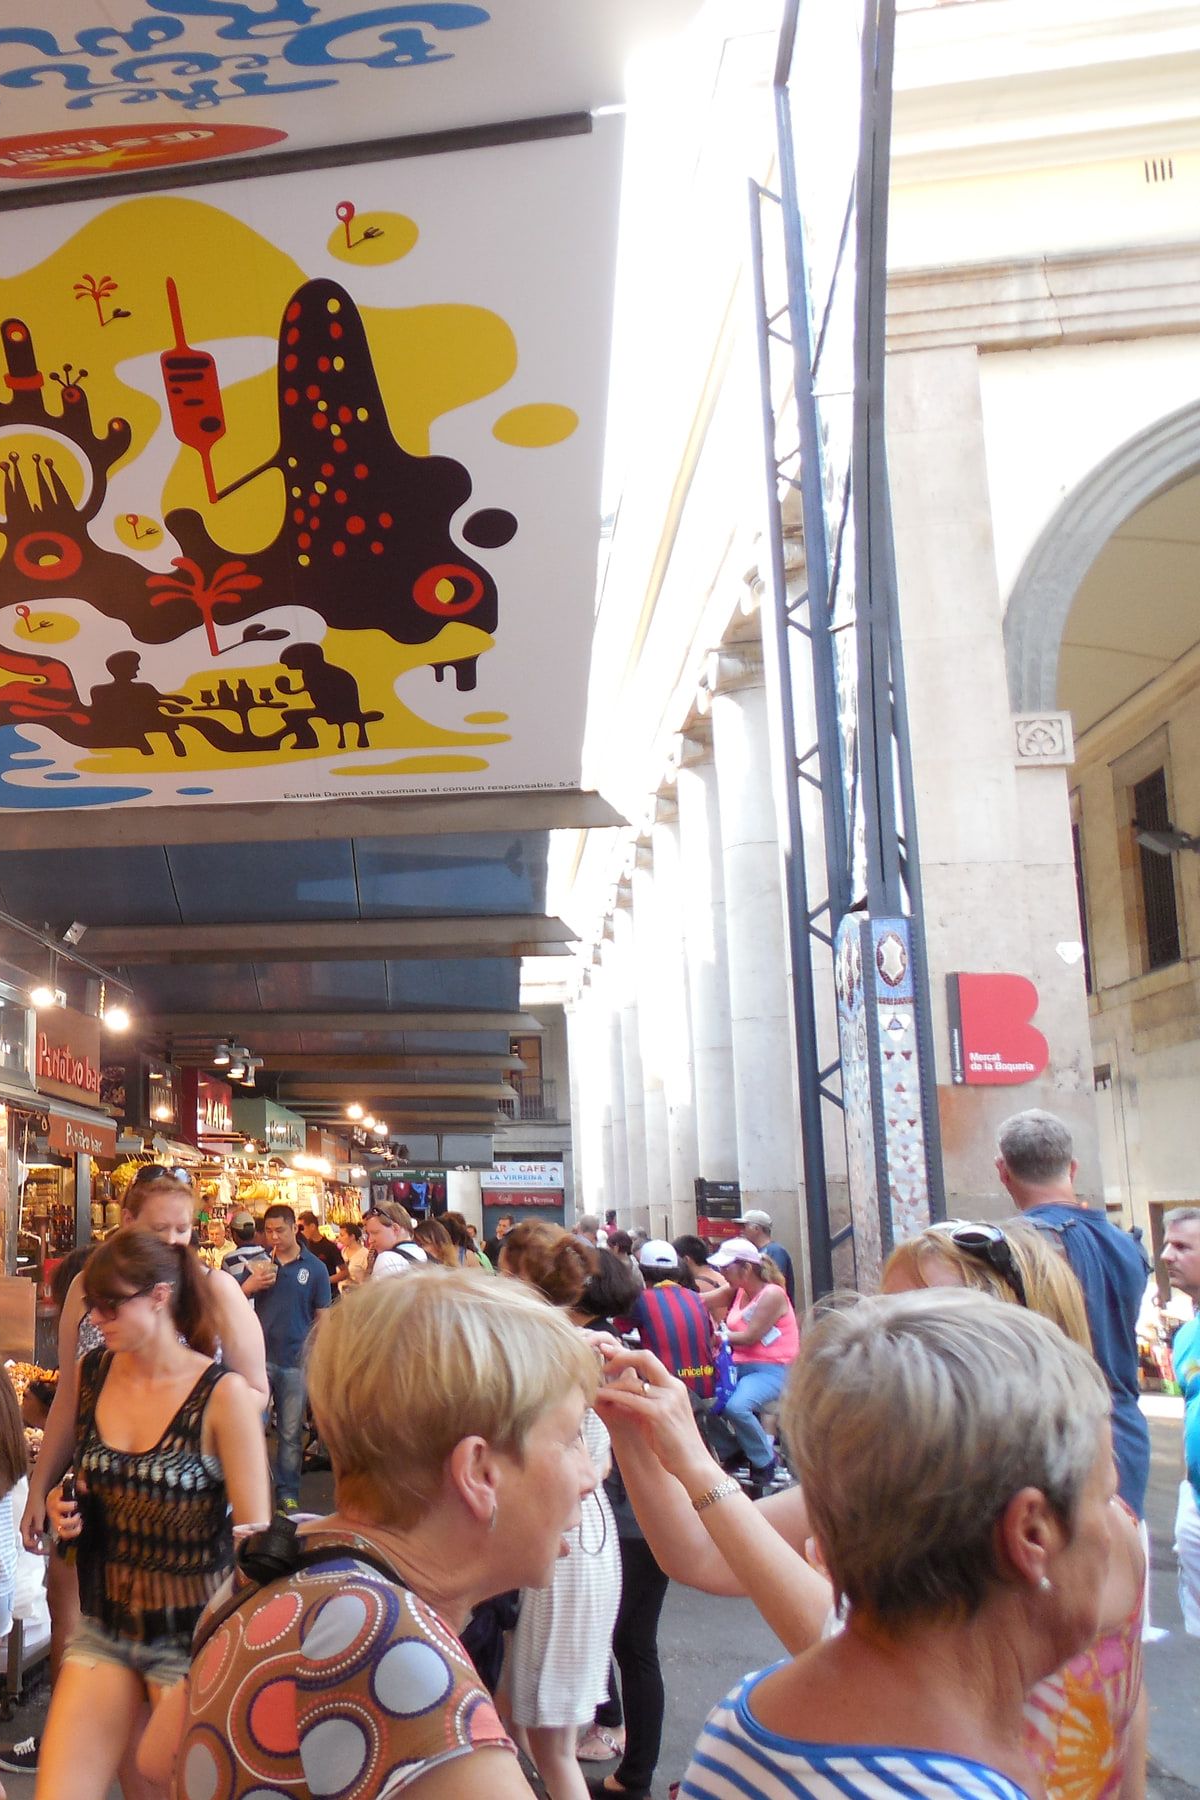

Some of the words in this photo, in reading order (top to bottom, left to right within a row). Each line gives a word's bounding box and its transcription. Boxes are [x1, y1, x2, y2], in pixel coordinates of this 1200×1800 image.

[283, 791, 322, 799] Estrella
[324, 790, 359, 798] Damm
[360, 789, 375, 797] en
[376, 786, 429, 795] recomana
[442, 784, 486, 793] consum
[968, 1052, 1001, 1062] Mercat
[970, 1062, 982, 1071] de
[984, 1062, 993, 1071] la
[677, 1365, 704, 1378] unicef
